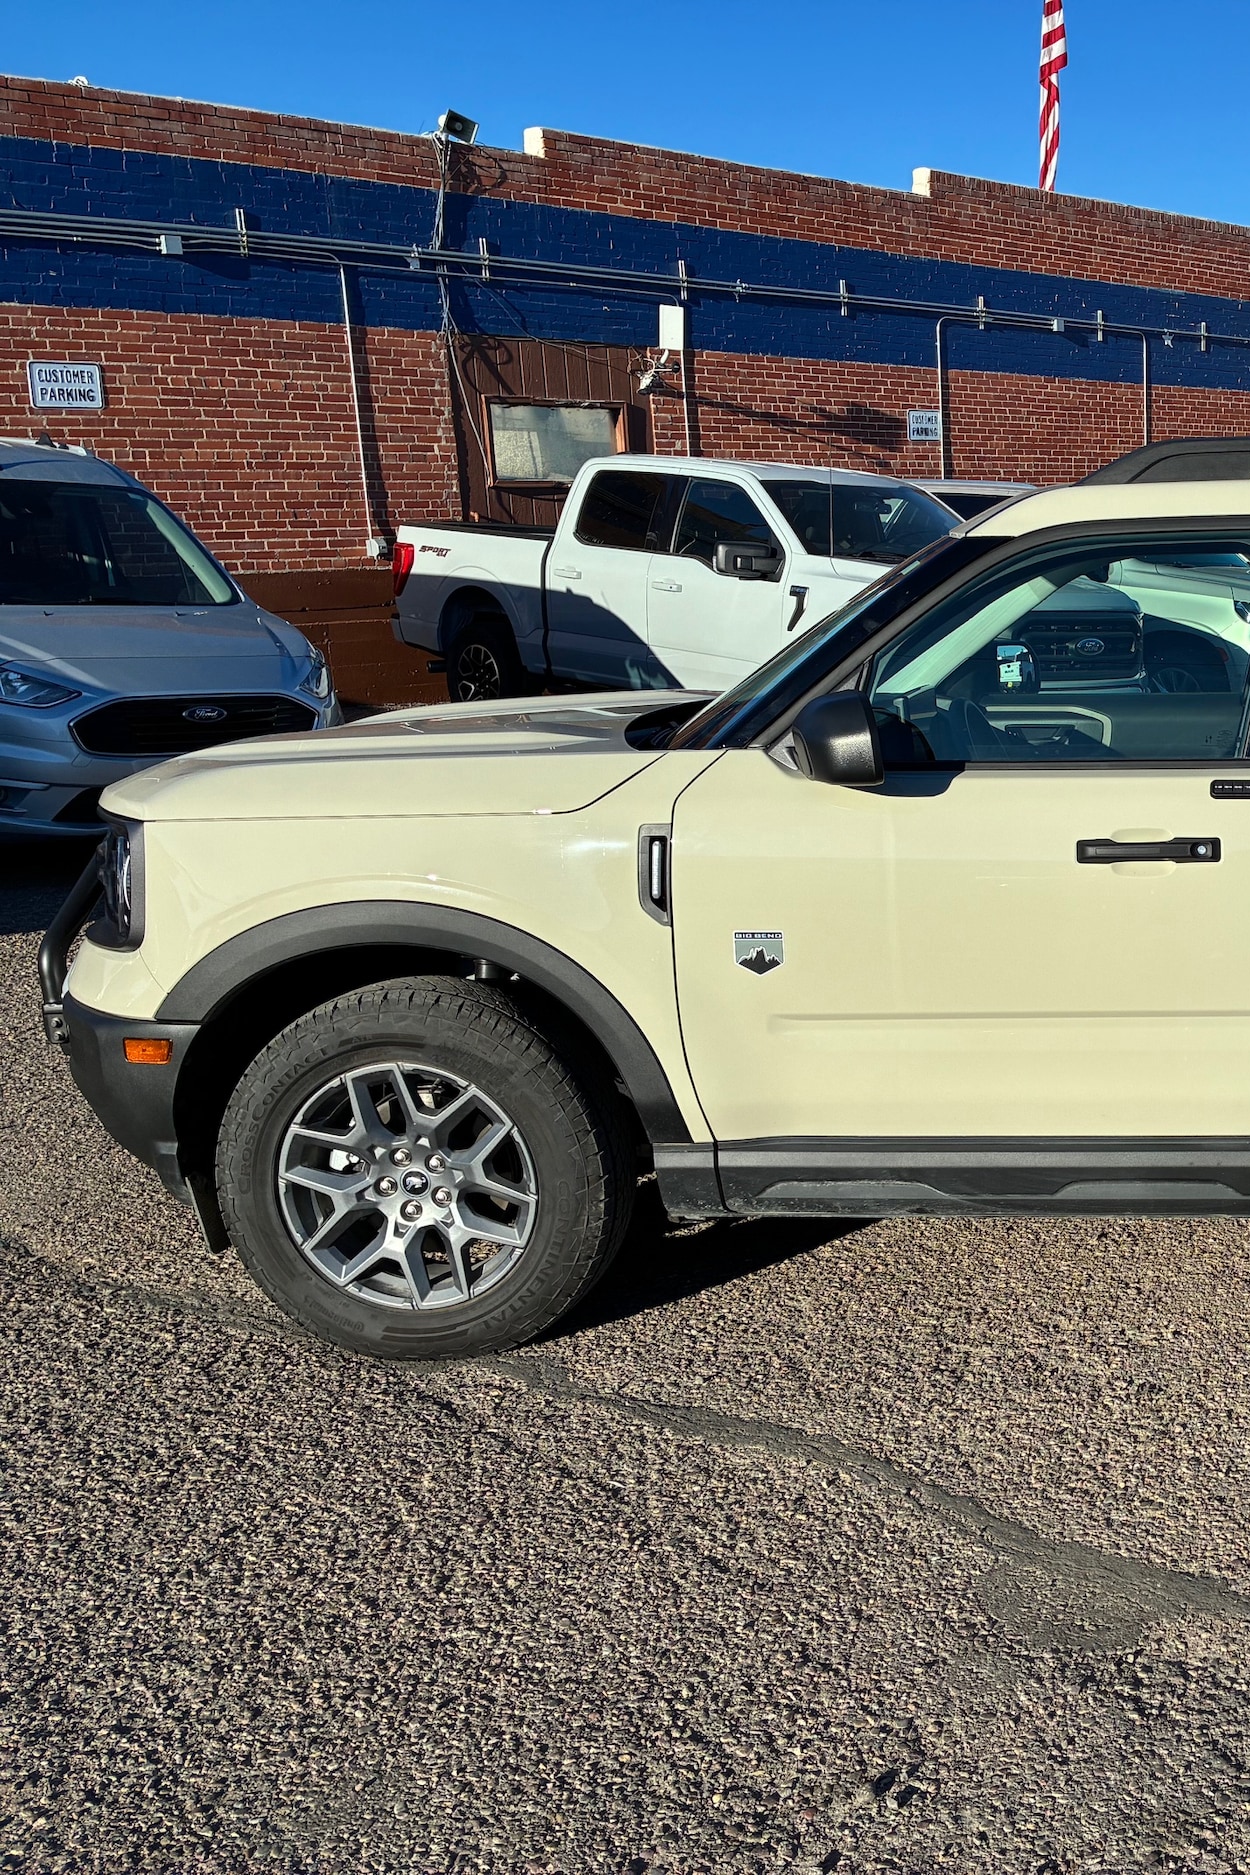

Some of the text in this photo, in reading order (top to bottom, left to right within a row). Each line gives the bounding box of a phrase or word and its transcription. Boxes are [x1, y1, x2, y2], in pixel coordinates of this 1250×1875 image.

[37, 369, 94, 385] CUSTOMER
[39, 387, 96, 402] PARKING
[911, 414, 938, 425] CUSTOMER
[419, 545, 451, 557] SPORT
